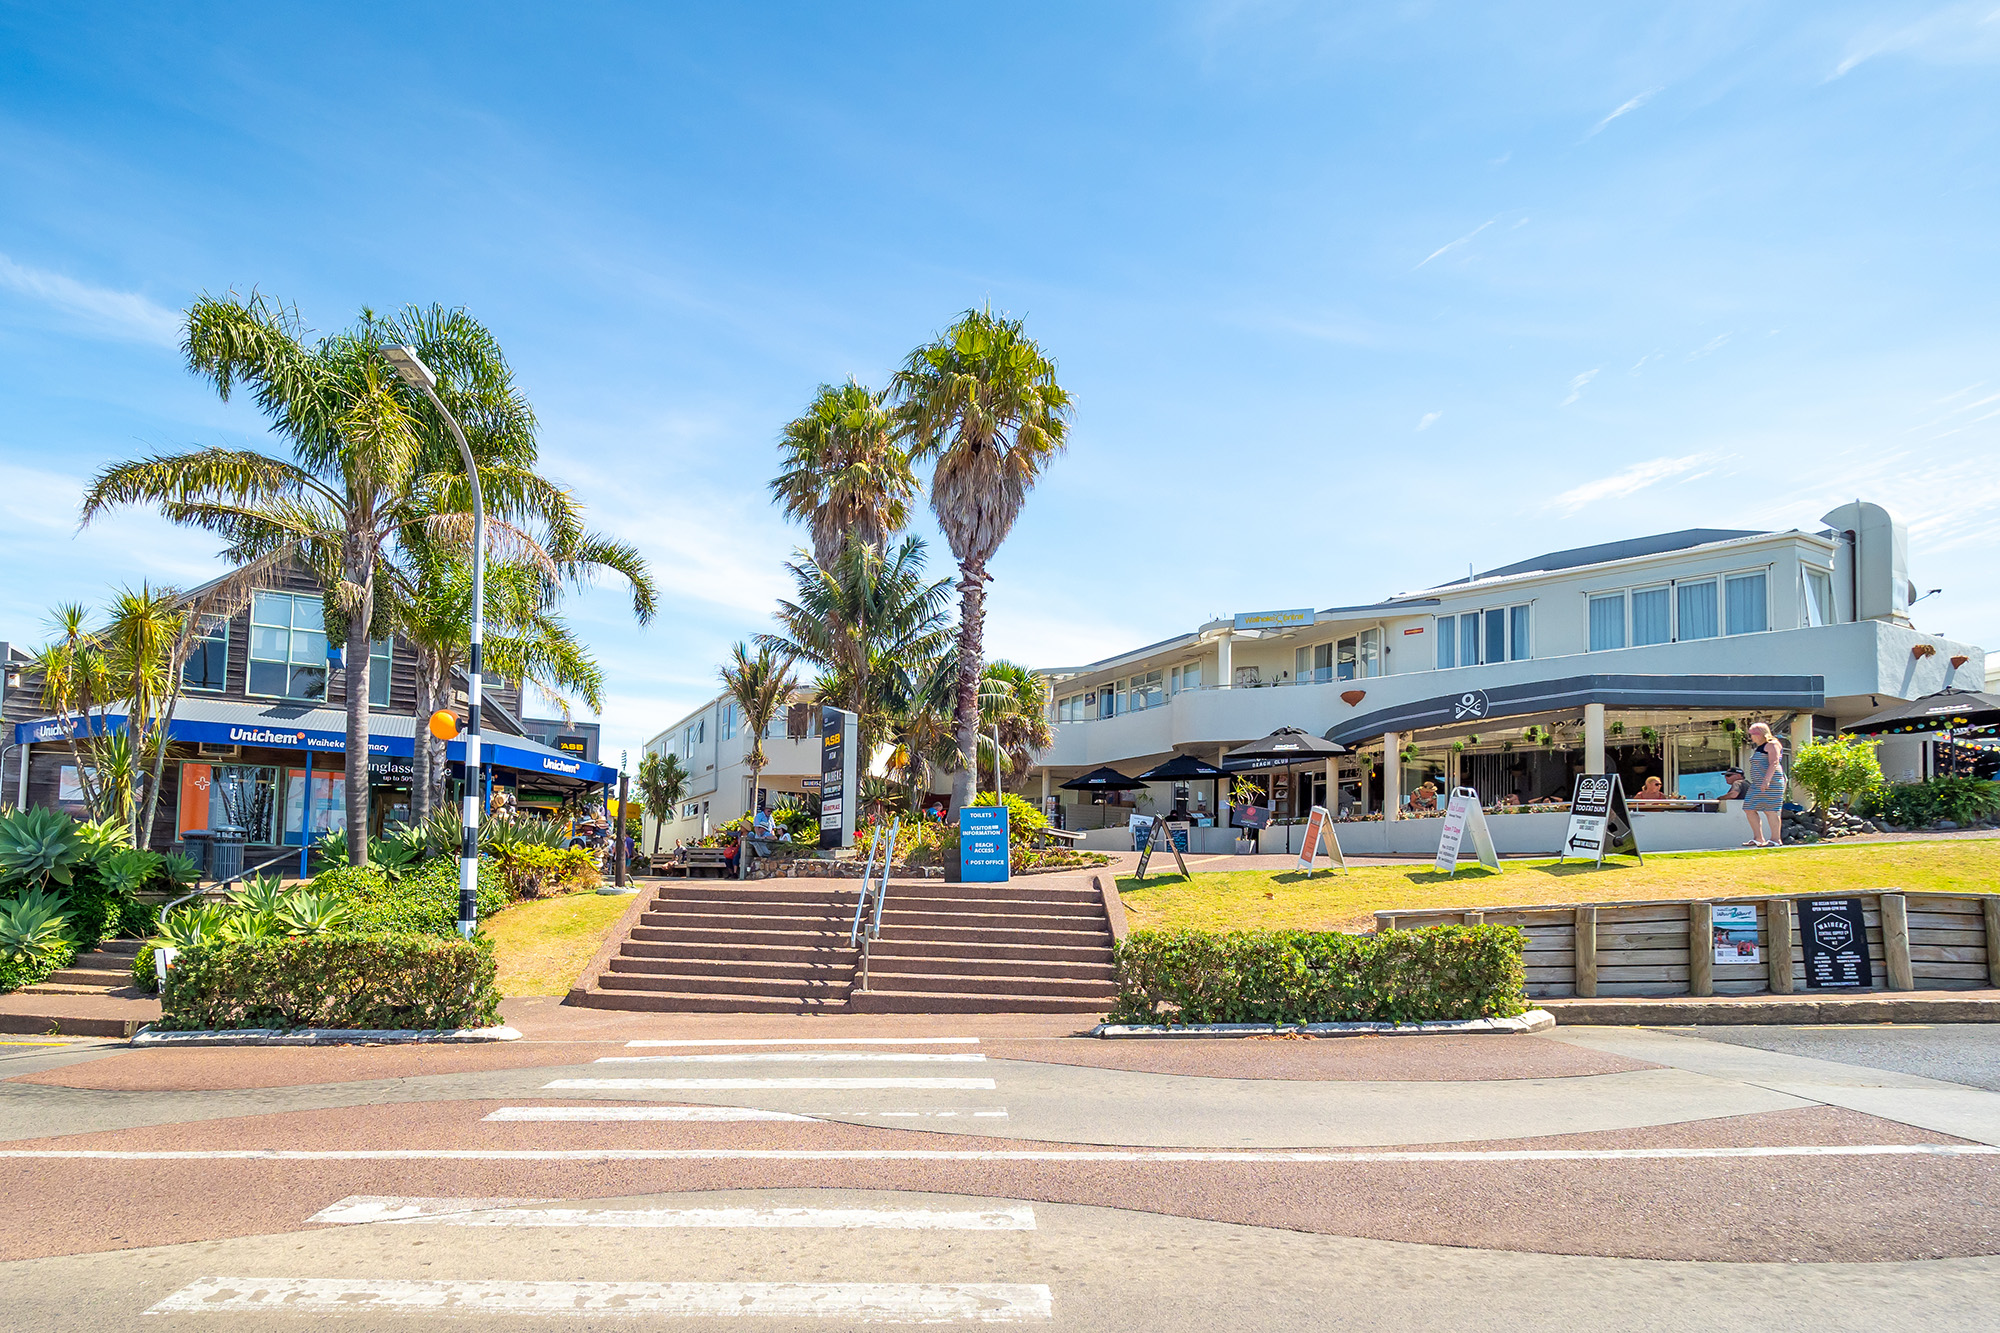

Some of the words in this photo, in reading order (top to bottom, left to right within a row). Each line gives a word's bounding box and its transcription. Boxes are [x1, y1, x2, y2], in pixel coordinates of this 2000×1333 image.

[229, 727, 298, 745] Unichem
[307, 737, 345, 749] Waiheke
[825, 733, 841, 747] ASB
[560, 742, 584, 751] ASB
[543, 757, 577, 774] Unichem
[1817, 921, 1849, 930] WAIHEKE
